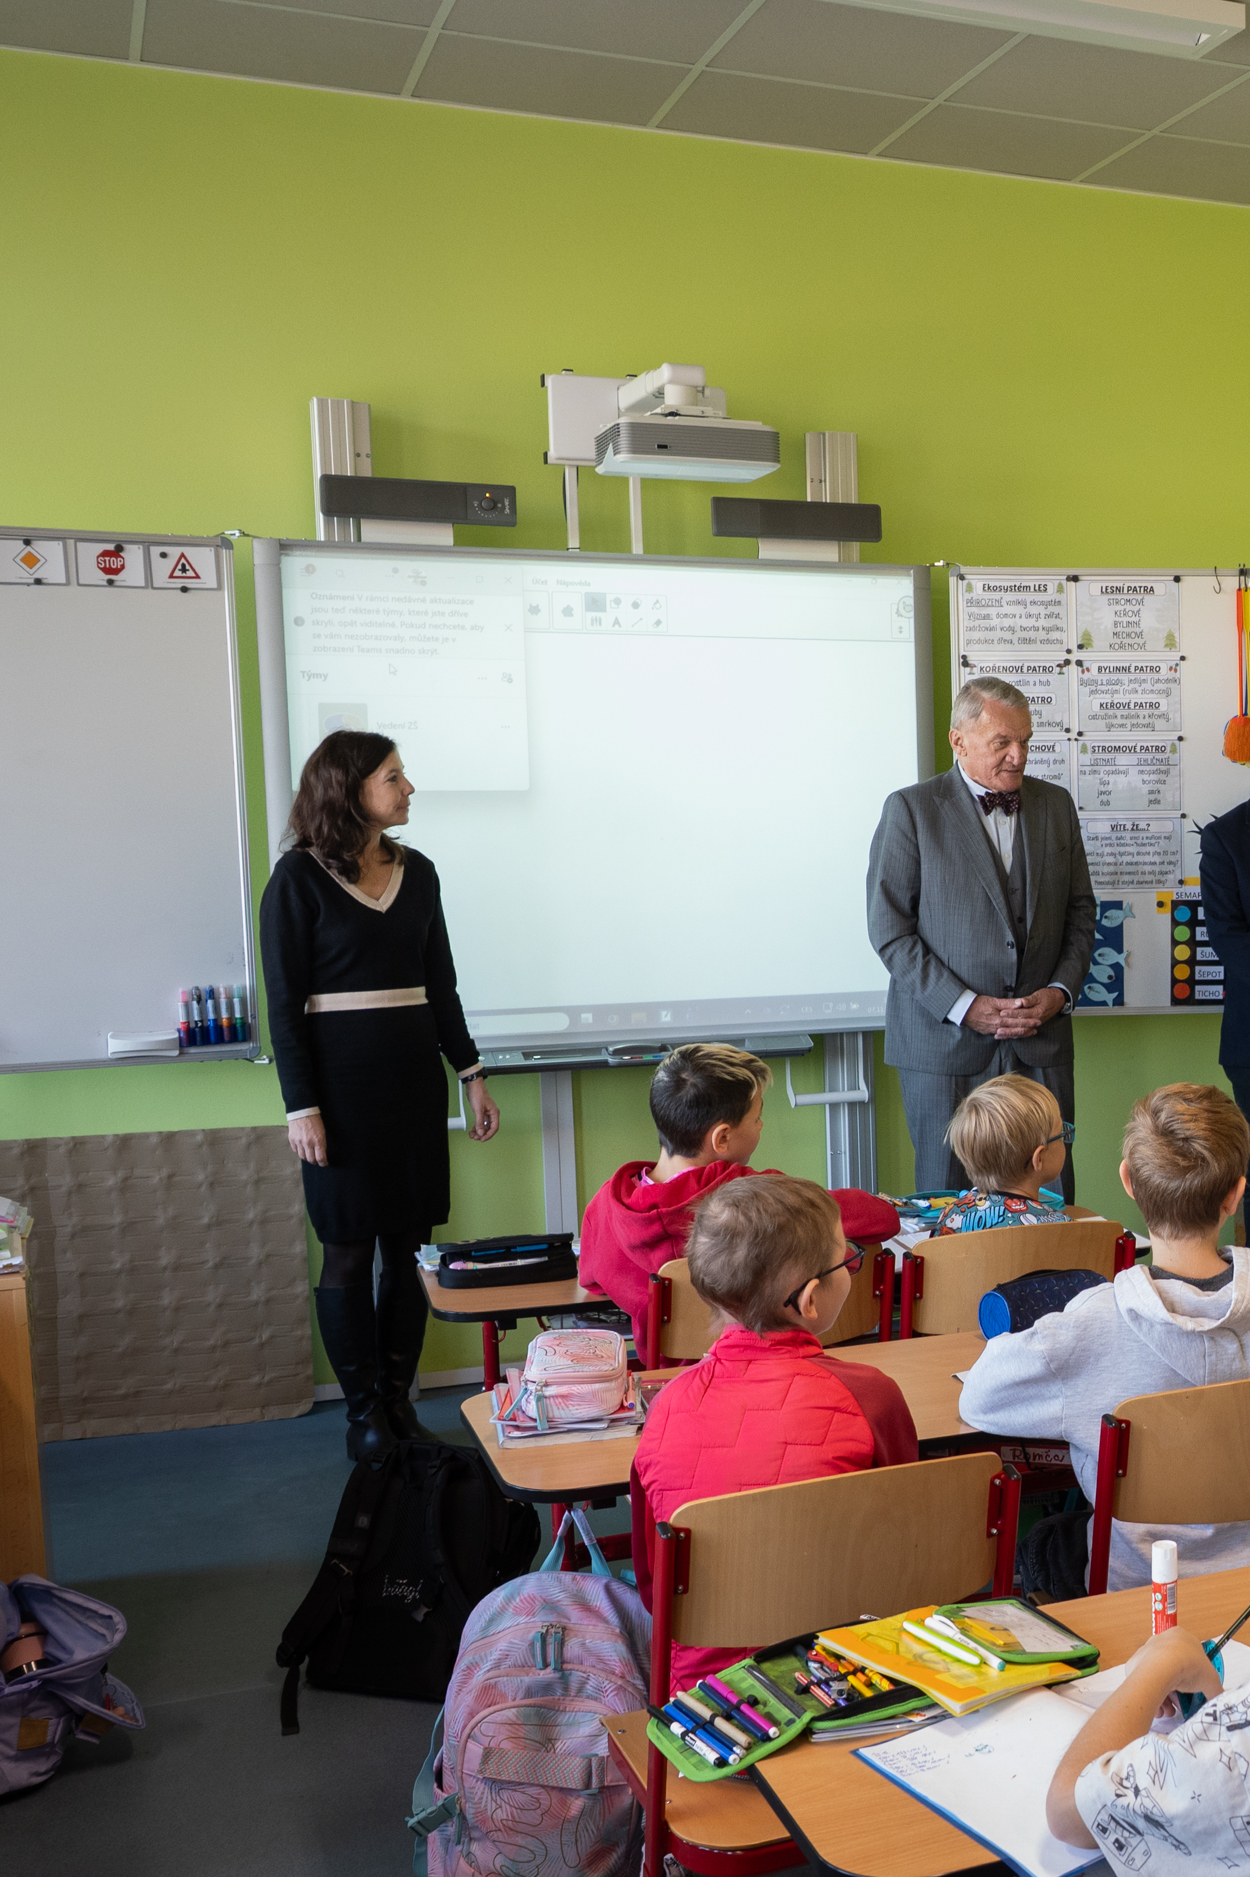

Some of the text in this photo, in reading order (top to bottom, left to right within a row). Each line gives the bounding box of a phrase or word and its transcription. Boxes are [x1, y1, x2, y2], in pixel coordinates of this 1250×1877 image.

[98, 557, 124, 569] STOP
[982, 582, 1048, 593] Ekosystém LES
[1100, 584, 1155, 594] LESNÍ PATRA
[310, 592, 354, 601] Oznámení
[366, 593, 389, 602] rámci
[392, 595, 427, 604] nedávné
[429, 597, 474, 605] aktualizace
[1107, 596, 1145, 606] STROMOVÉ
[310, 605, 329, 615] jsou
[349, 606, 380, 615] některé
[408, 608, 429, 617] které
[431, 609, 446, 618] jste
[448, 610, 468, 618] dříve
[1115, 608, 1141, 618] KEŘOVÉ
[1025, 612, 1041, 622] úkryt
[338, 620, 357, 628] opět
[400, 621, 426, 629] Pokud
[470, 624, 484, 632] aby
[1114, 619, 1141, 628] BYLINNÉ
[324, 632, 341, 640] vám
[409, 634, 439, 642] můžete
[441, 635, 449, 644] je
[1113, 630, 1144, 639] MECHOVÉ
[966, 638, 994, 647] produkce
[1109, 641, 1147, 650] KOŘENOVÉ
[313, 644, 354, 653] zobrazení
[356, 645, 382, 653] Teams
[418, 647, 439, 656] skrýt.
[980, 663, 1024, 673] KOŘENOVÉ
[1098, 664, 1132, 673] BYLINNÉ
[300, 670, 329, 682] Týmy
[1088, 688, 1120, 697] jedovatými
[1100, 700, 1132, 709] KEŘOVÉ
[1031, 709, 1042, 718] uby
[376, 720, 418, 730] Vedení ZŠ
[1036, 720, 1064, 730] smrkový
[1130, 722, 1155, 731] jedovatý
[1030, 742, 1056, 752] CHOVÉ
[1091, 743, 1138, 753] STROMOVÉ
[1090, 756, 1117, 765] LISTNATÉ
[1136, 756, 1170, 765] JEHLIČNATÉ
[1103, 768, 1129, 777] opadávají
[1138, 768, 1170, 777] neopadávají
[1097, 789, 1112, 798] javor
[1148, 798, 1161, 807] jedle
[1110, 822, 1129, 832] VÍTE,
[961, 1205, 1005, 1233] WOW!
